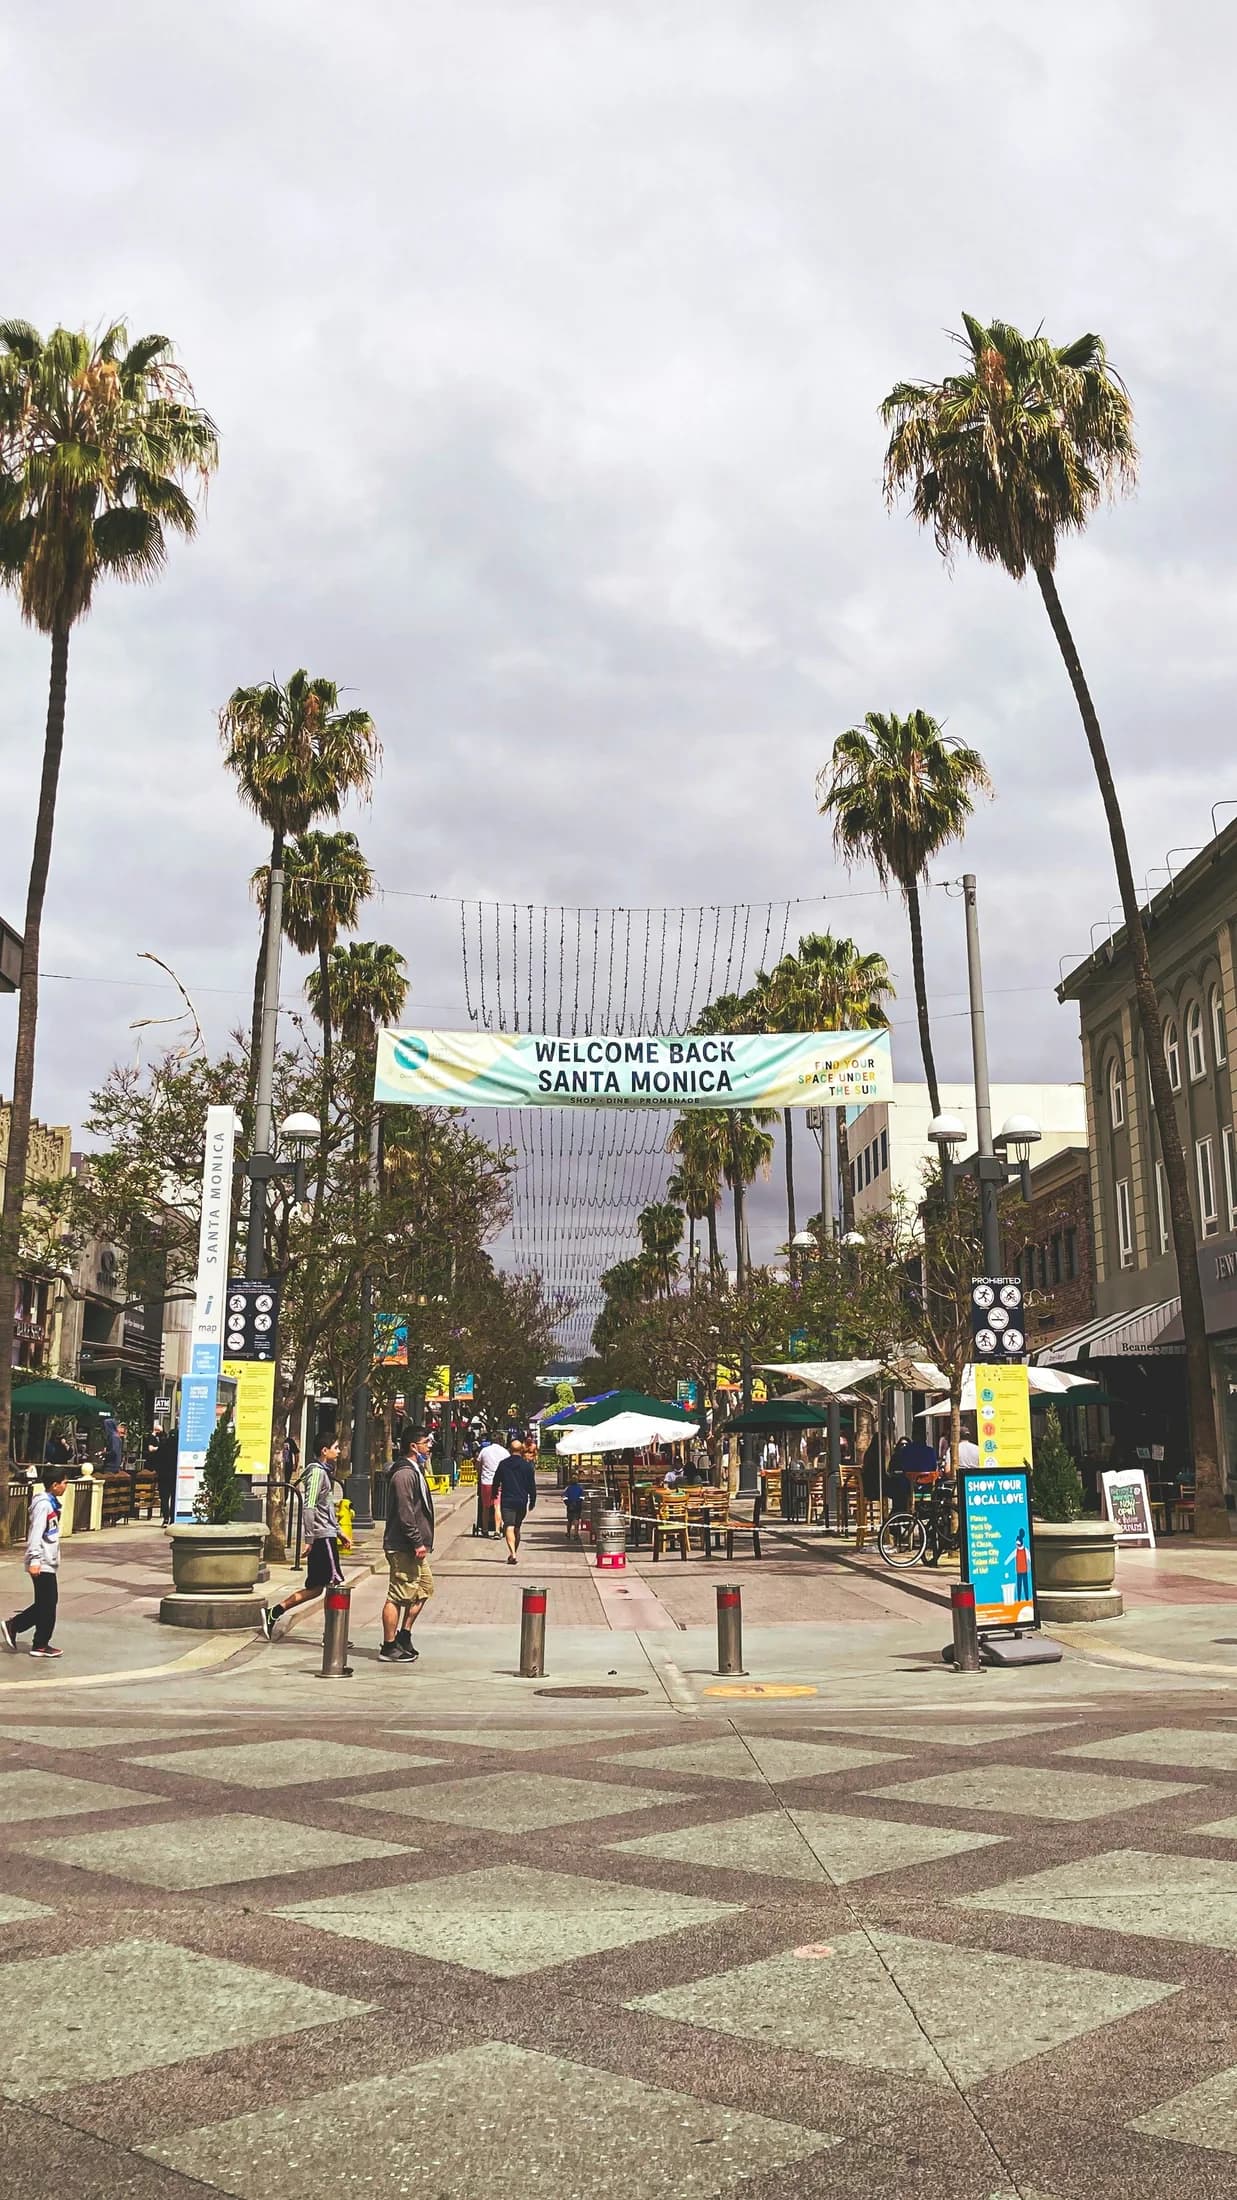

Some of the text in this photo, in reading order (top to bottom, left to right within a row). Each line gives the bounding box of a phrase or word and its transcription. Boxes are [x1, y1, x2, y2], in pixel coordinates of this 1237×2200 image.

[535, 1041, 736, 1064] WELCOME BACK
[815, 1059, 875, 1070] FIND YOUR
[538, 1070, 733, 1092] SANTA MONICA
[798, 1072, 875, 1084] SPACE UNDER
[829, 1085, 877, 1096] THE SUN
[207, 1132, 225, 1264] SANTA MONICA
[1215, 1252, 1237, 1280] JEW
[971, 1277, 1022, 1285] PROHIBITED
[198, 1324, 217, 1334] map
[156, 1399, 169, 1407] ATM
[968, 1479, 1022, 1492] SHOW YOUR
[968, 1493, 1025, 1506] LOCAL LOVE
